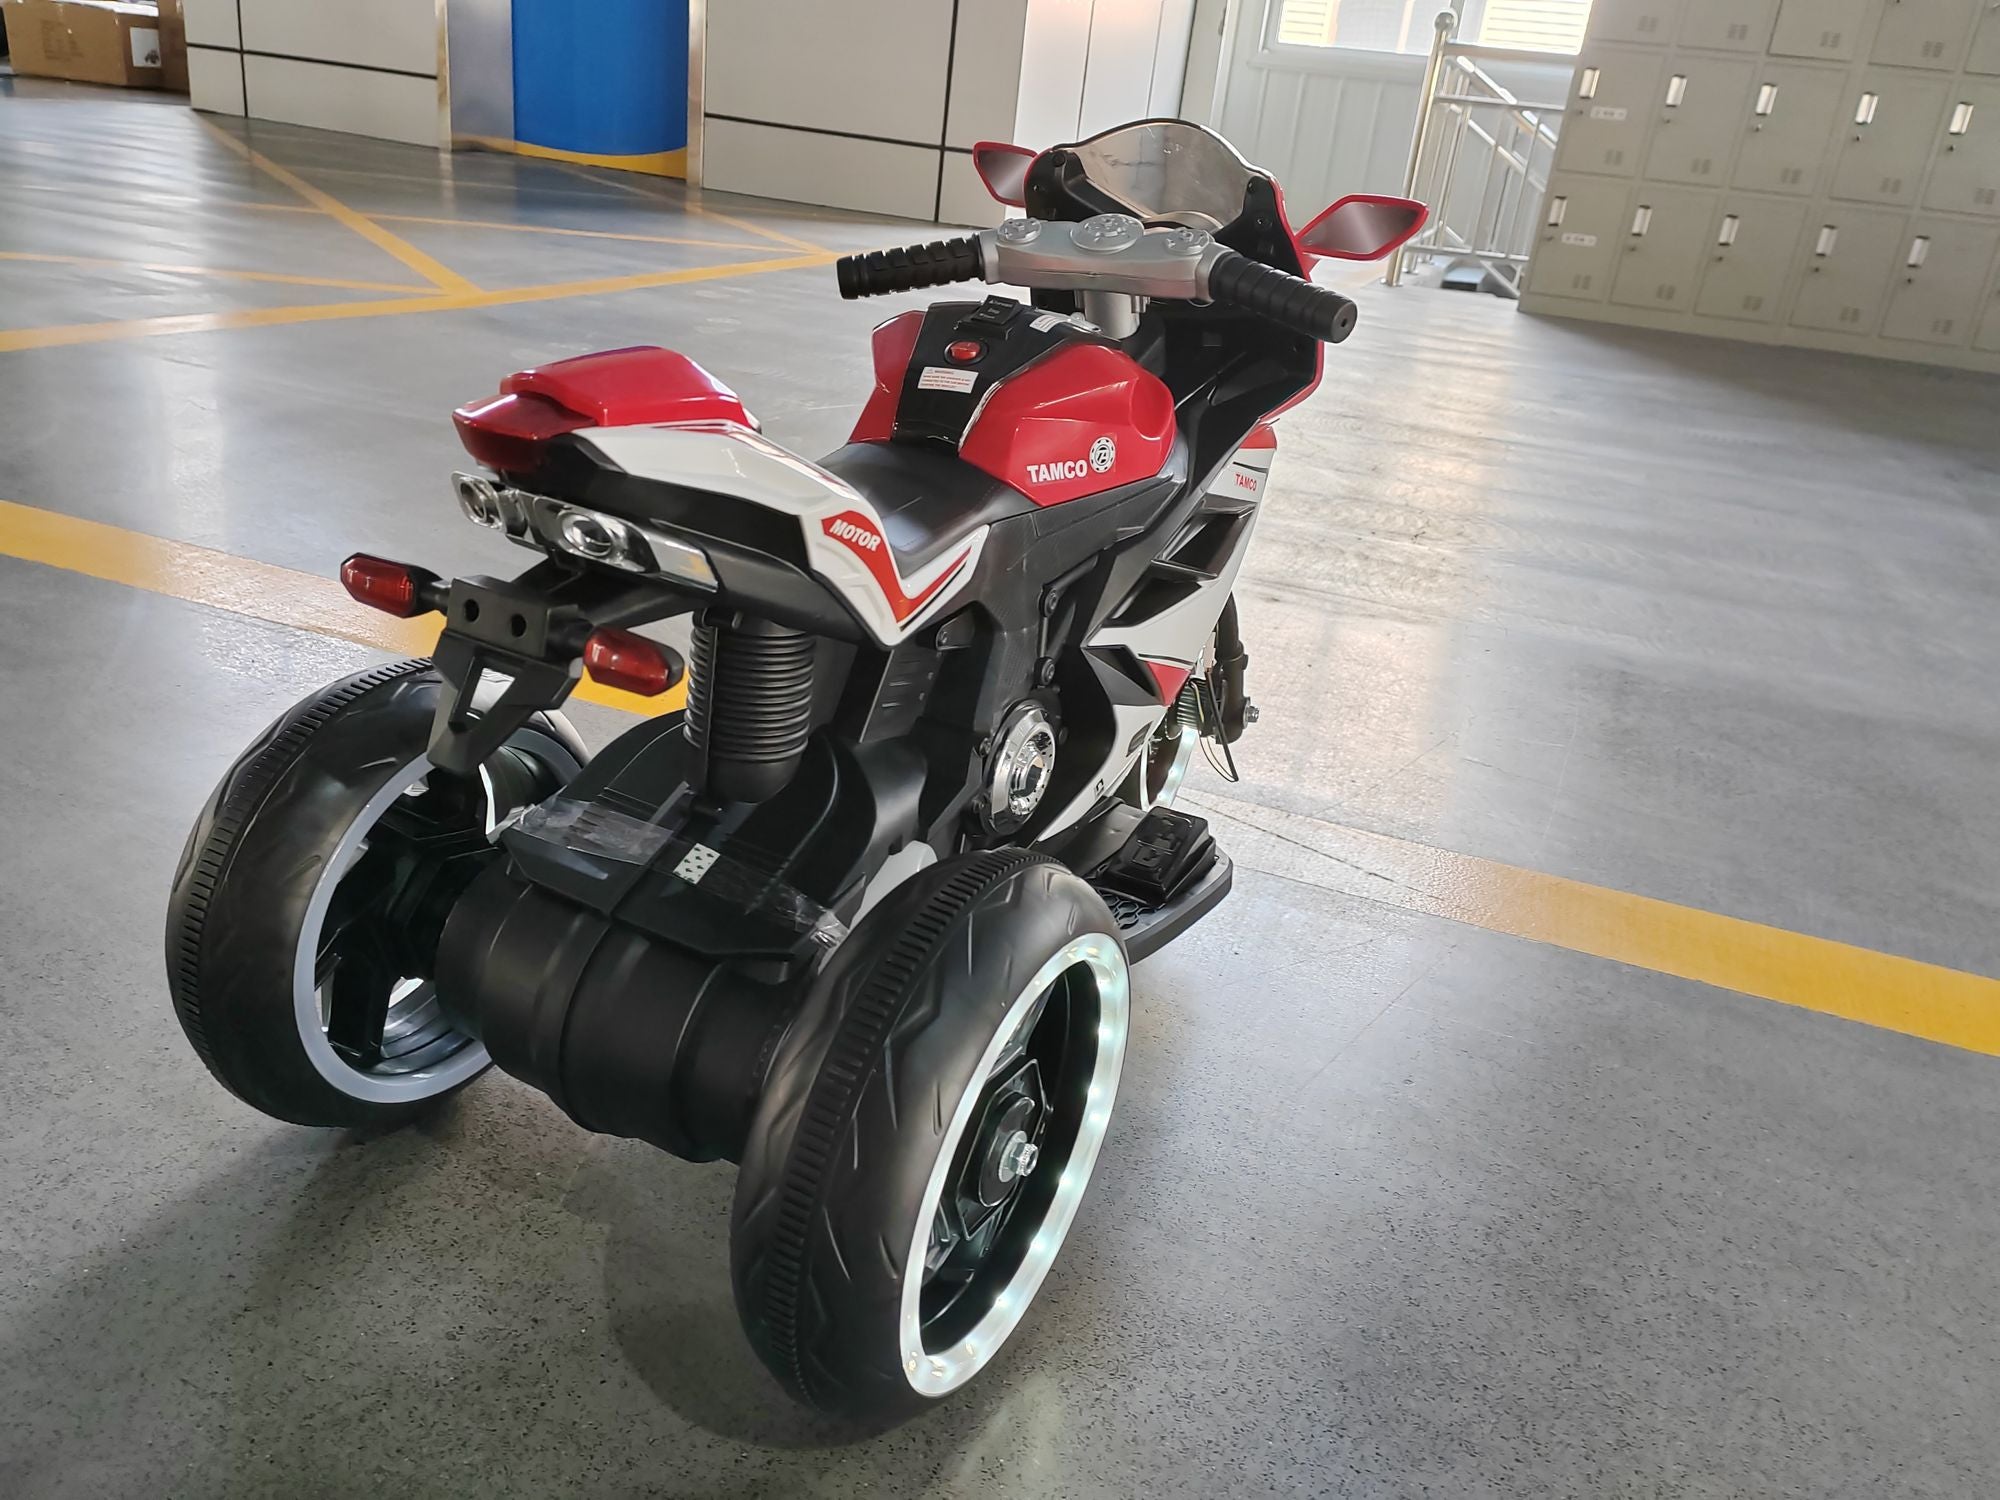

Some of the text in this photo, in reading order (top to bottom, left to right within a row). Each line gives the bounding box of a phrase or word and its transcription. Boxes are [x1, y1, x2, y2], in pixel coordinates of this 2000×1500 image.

[1026, 459, 1088, 483] TAMCO
[1235, 473, 1257, 491] TAMCO
[829, 518, 882, 552] MOTOR
